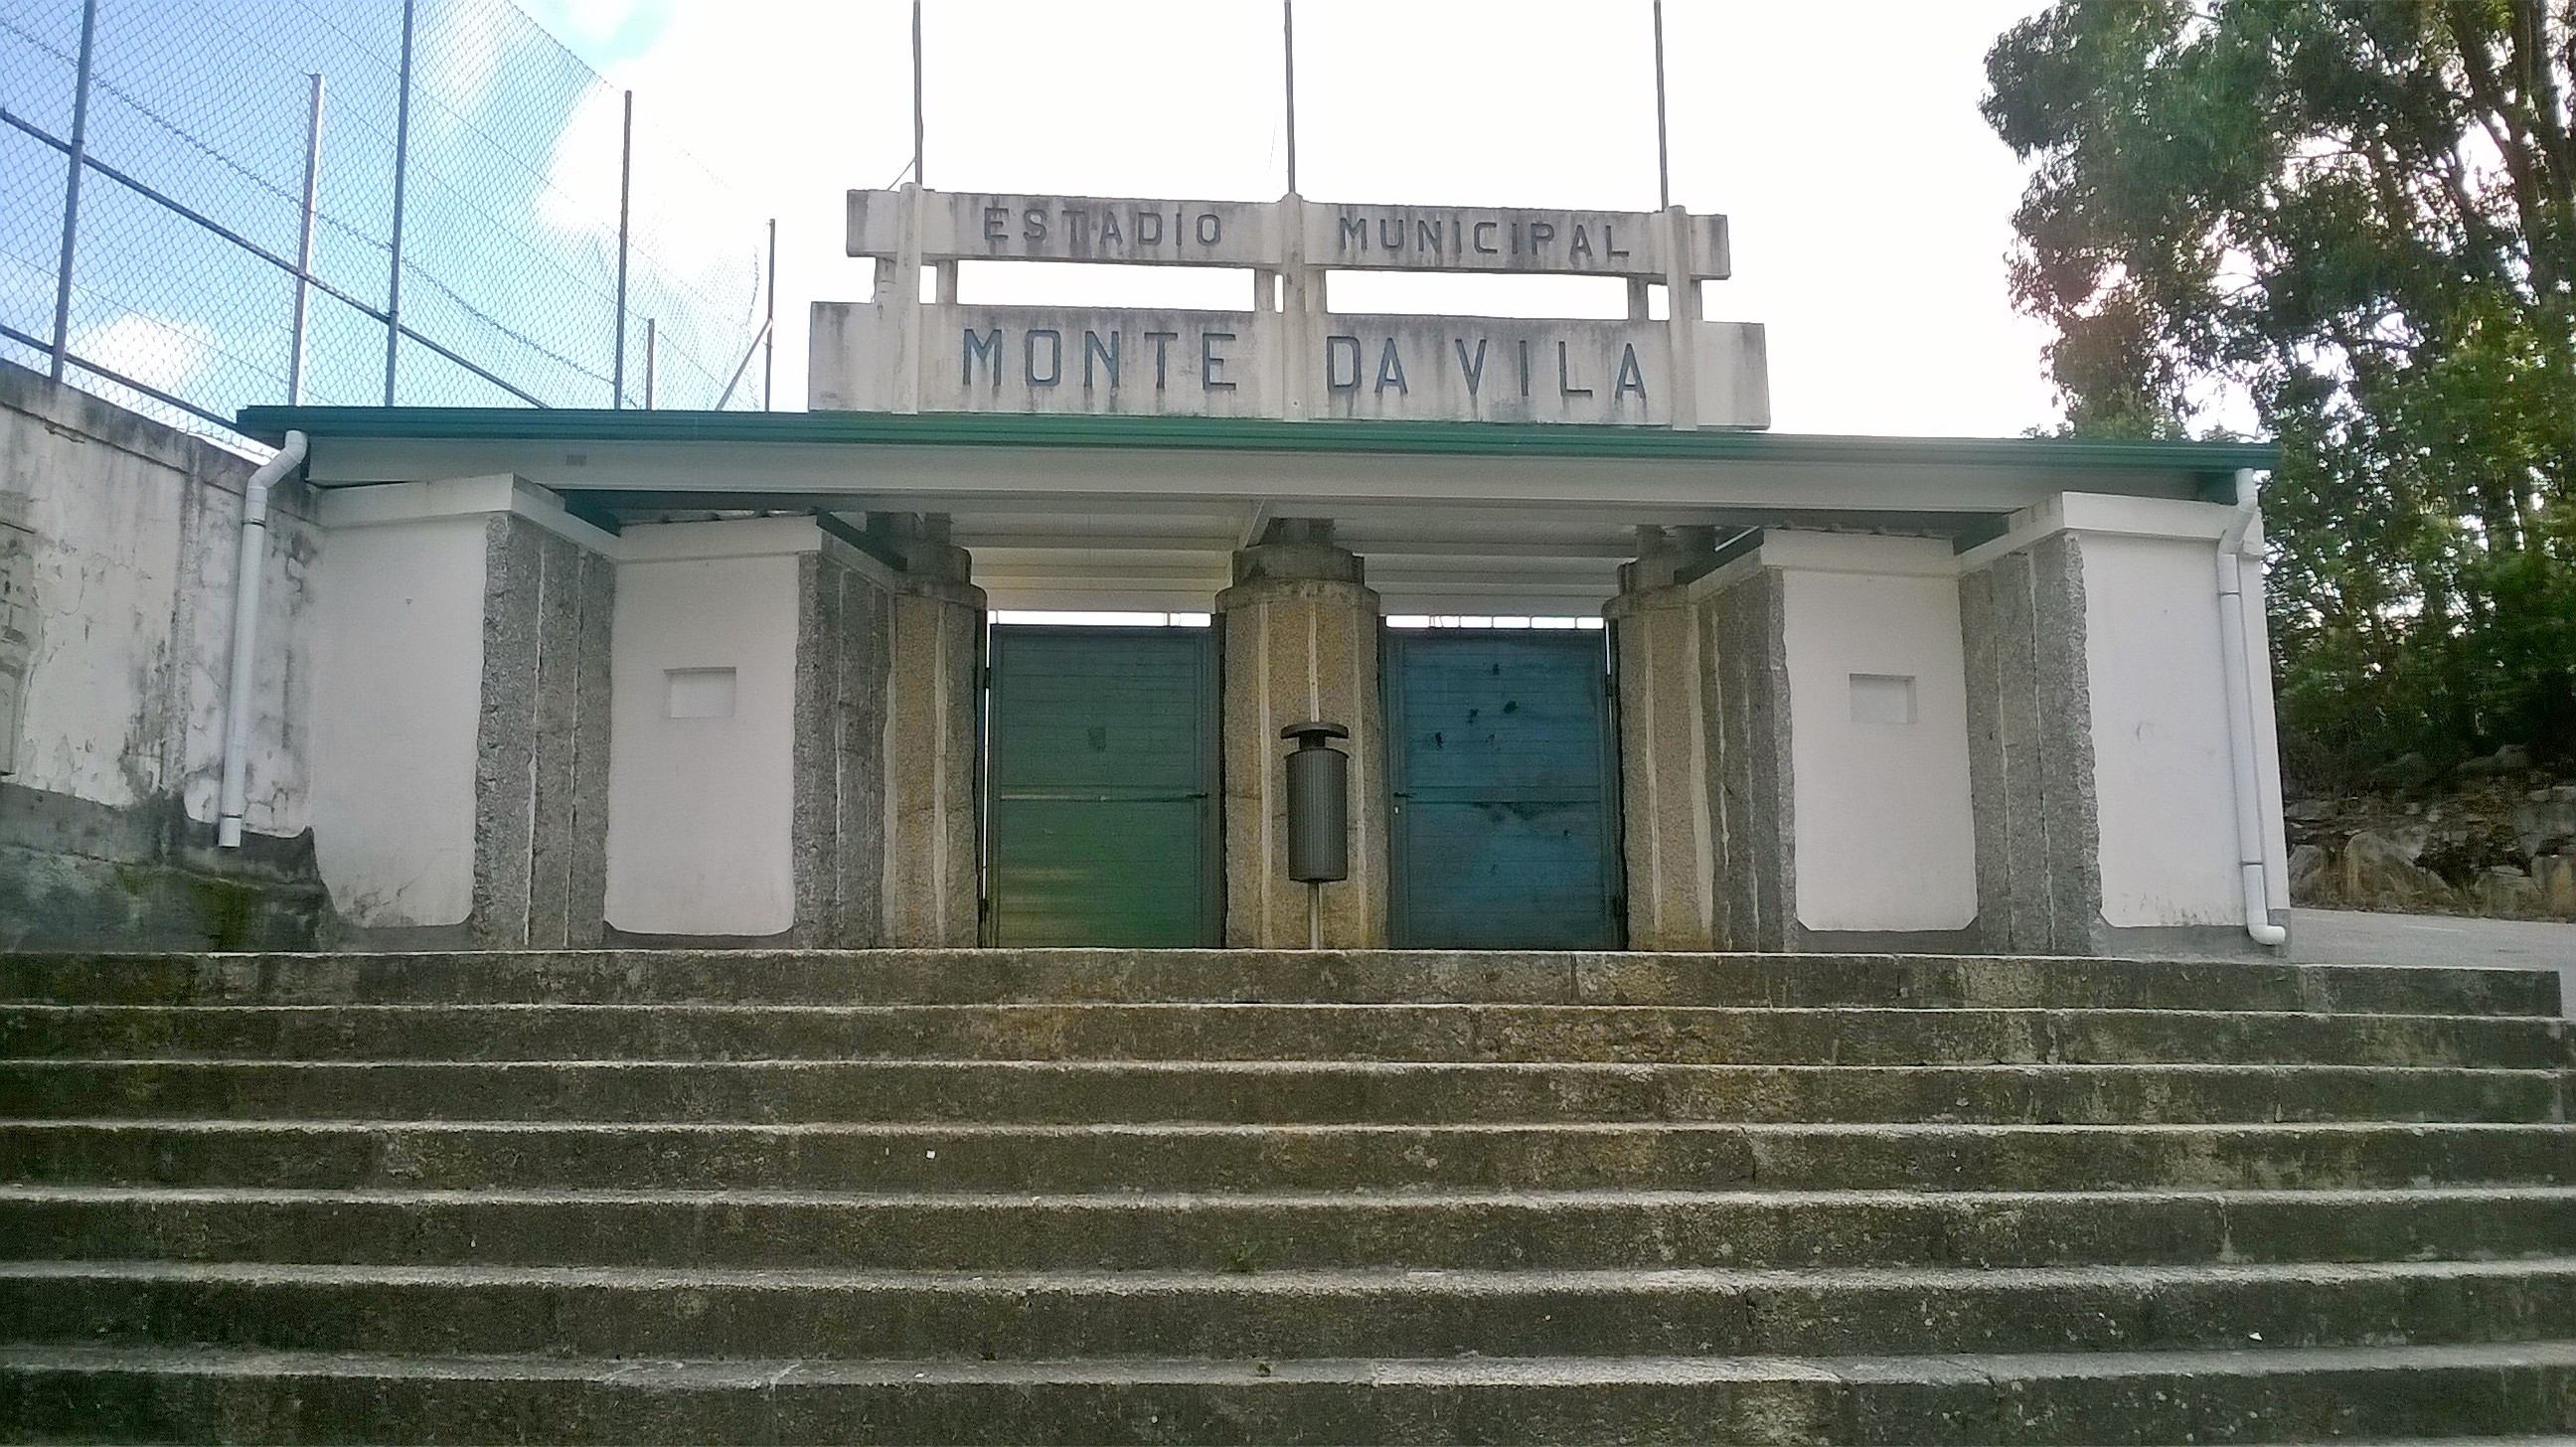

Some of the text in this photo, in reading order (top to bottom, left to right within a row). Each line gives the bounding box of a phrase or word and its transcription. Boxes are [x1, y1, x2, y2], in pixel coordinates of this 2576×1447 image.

[984, 207, 1631, 257] ESTADIO MUNICIPAL
[962, 328, 1237, 391] MONTE
